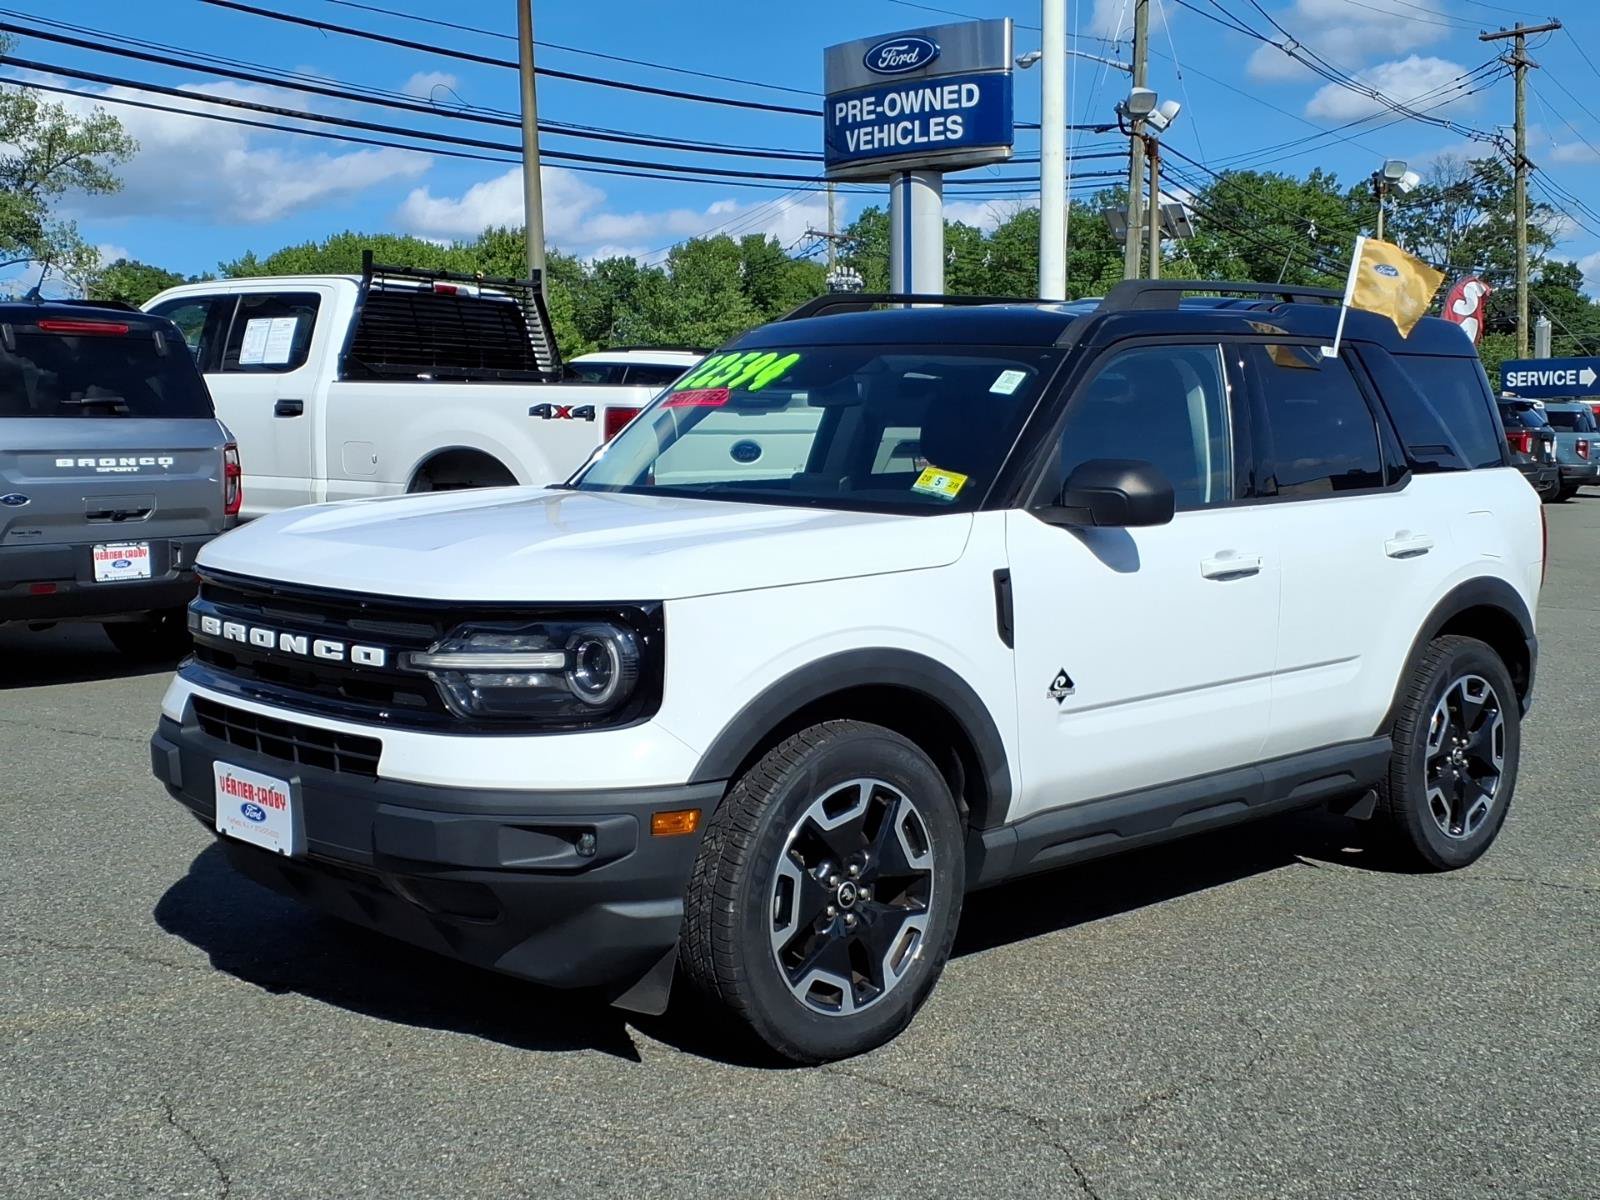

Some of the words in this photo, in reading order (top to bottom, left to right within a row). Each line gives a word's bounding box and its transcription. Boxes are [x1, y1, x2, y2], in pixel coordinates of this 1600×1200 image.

[878, 45, 919, 68] Ford
[835, 83, 980, 126] PRE-OWNED
[845, 115, 963, 153] VEHICLES
[1506, 369, 1577, 387] SERVICE
[55, 456, 174, 467] BRONCO
[202, 615, 385, 667] BRONCO
[244, 804, 262, 820] Ford
